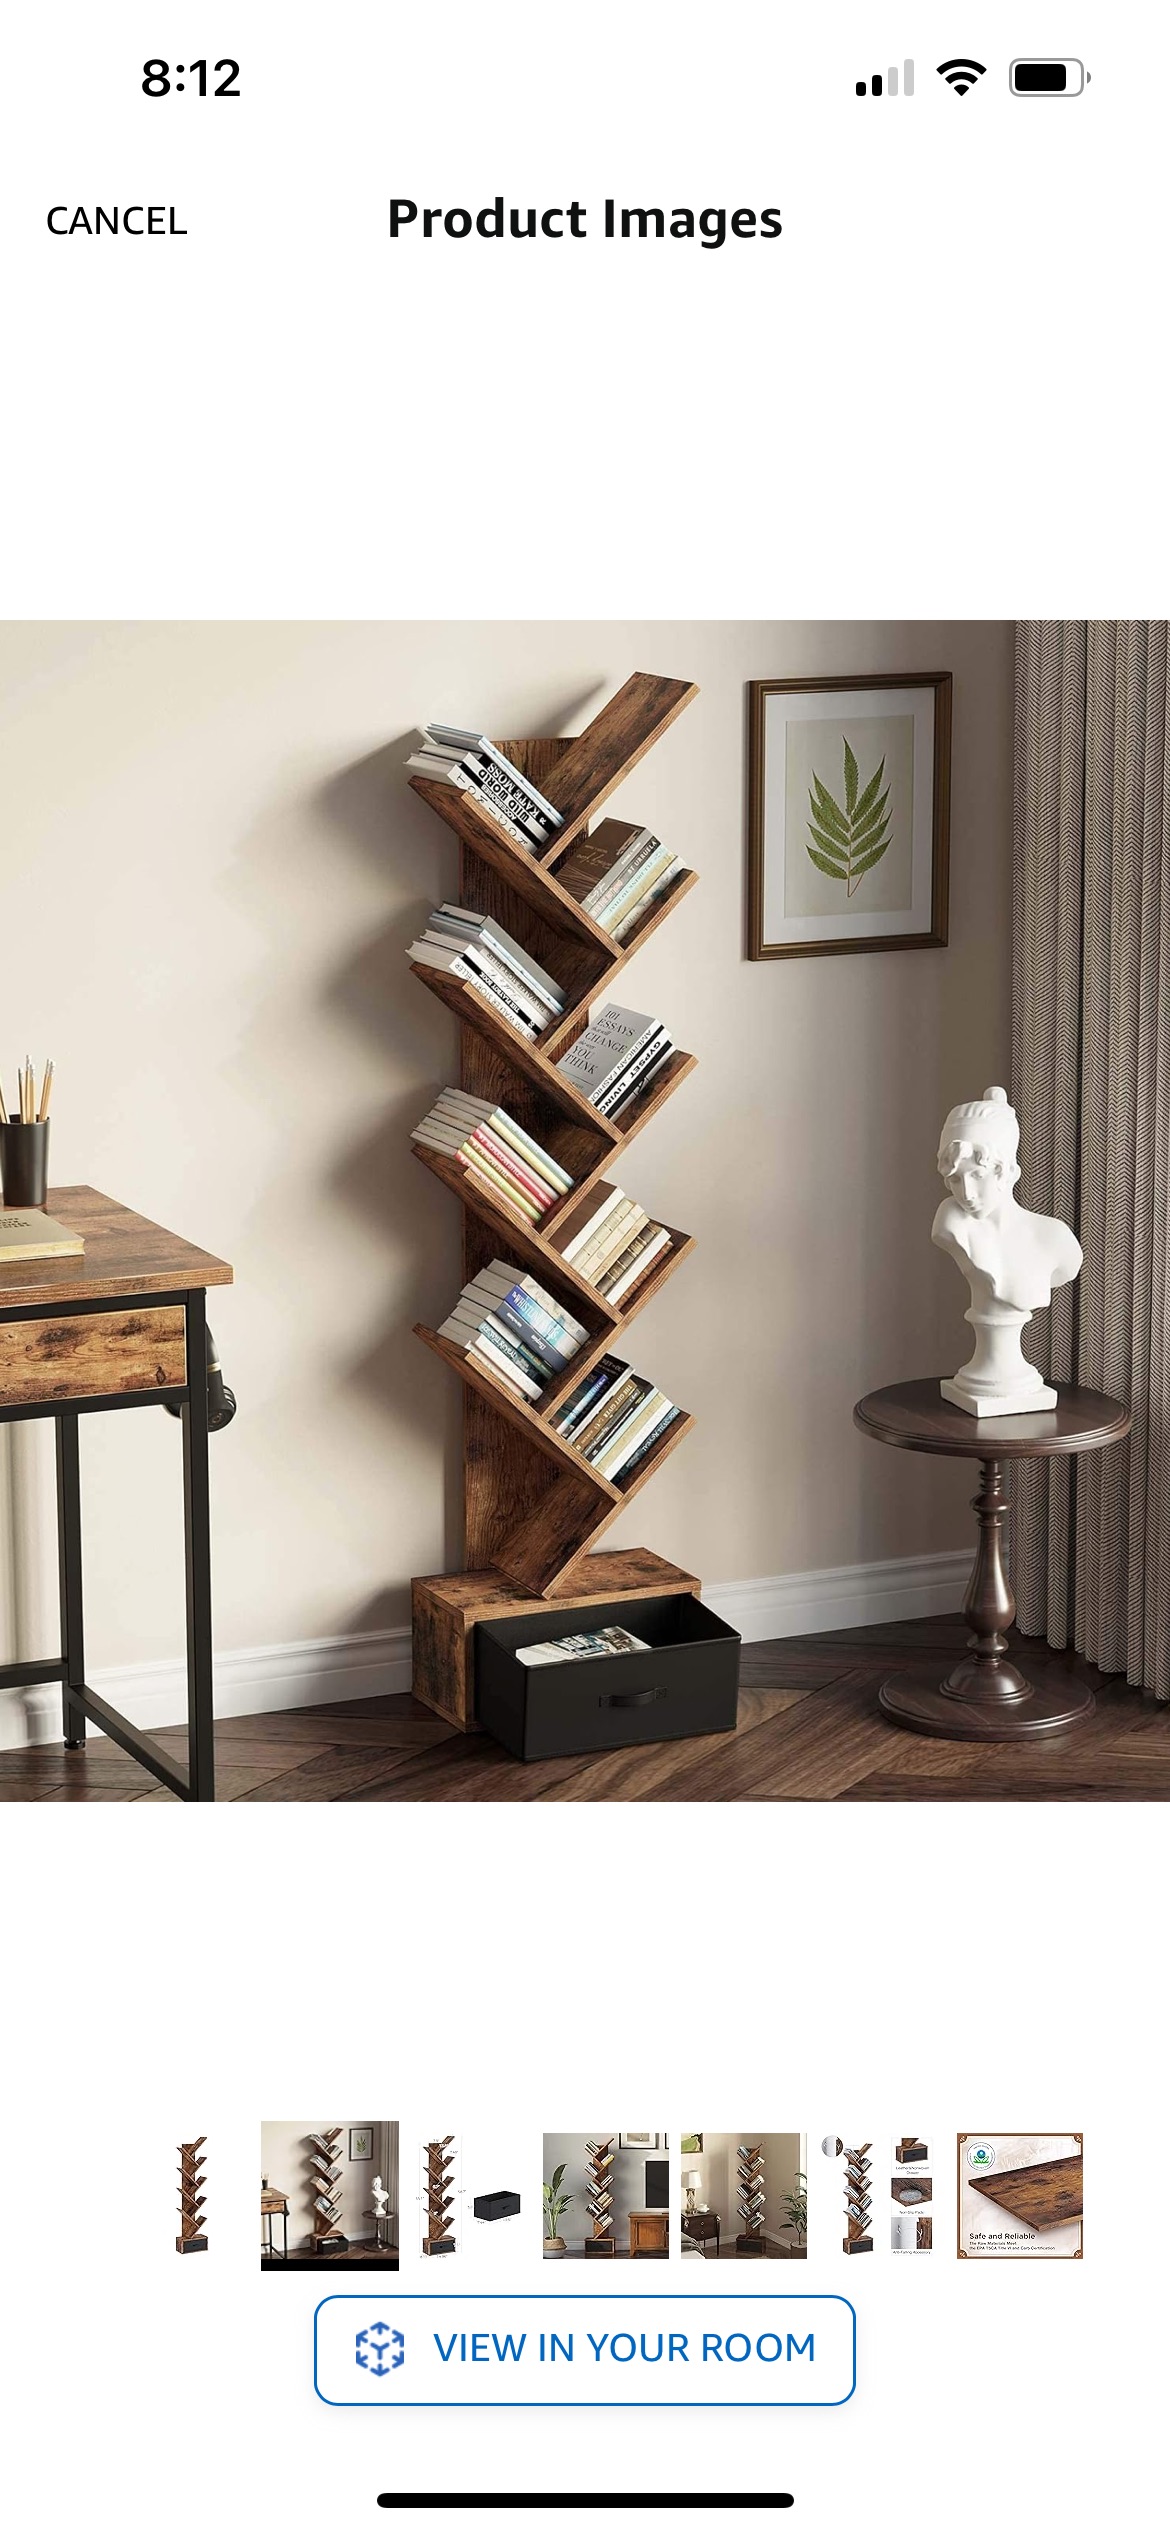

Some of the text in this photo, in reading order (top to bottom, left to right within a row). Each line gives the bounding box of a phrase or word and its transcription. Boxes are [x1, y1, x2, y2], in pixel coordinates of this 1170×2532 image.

[142, 59, 240, 97] 8:12
[47, 206, 187, 235] CANCEL
[390, 197, 782, 249] Product Images
[487, 762, 516, 792] MOSS
[477, 768, 530, 822] WILD WORLD
[512, 788, 540, 818] KATE
[490, 983, 512, 1004] PLAYBOY
[517, 982, 538, 1003] WALKER
[509, 1001, 520, 1013] THE
[604, 1009, 620, 1020] 101
[597, 1018, 635, 1037] ESSAYS
[572, 1045, 593, 1060] YOU
[584, 1031, 628, 1053] CHANGE
[616, 1029, 652, 1070] AMERICAN
[563, 1053, 598, 1074] THINK
[598, 1041, 661, 1113] GYPSET LIVING
[969, 2232, 1036, 2240] Safe and Reliable
[433, 2333, 814, 2362] VIEW IN YOUR ROOM
